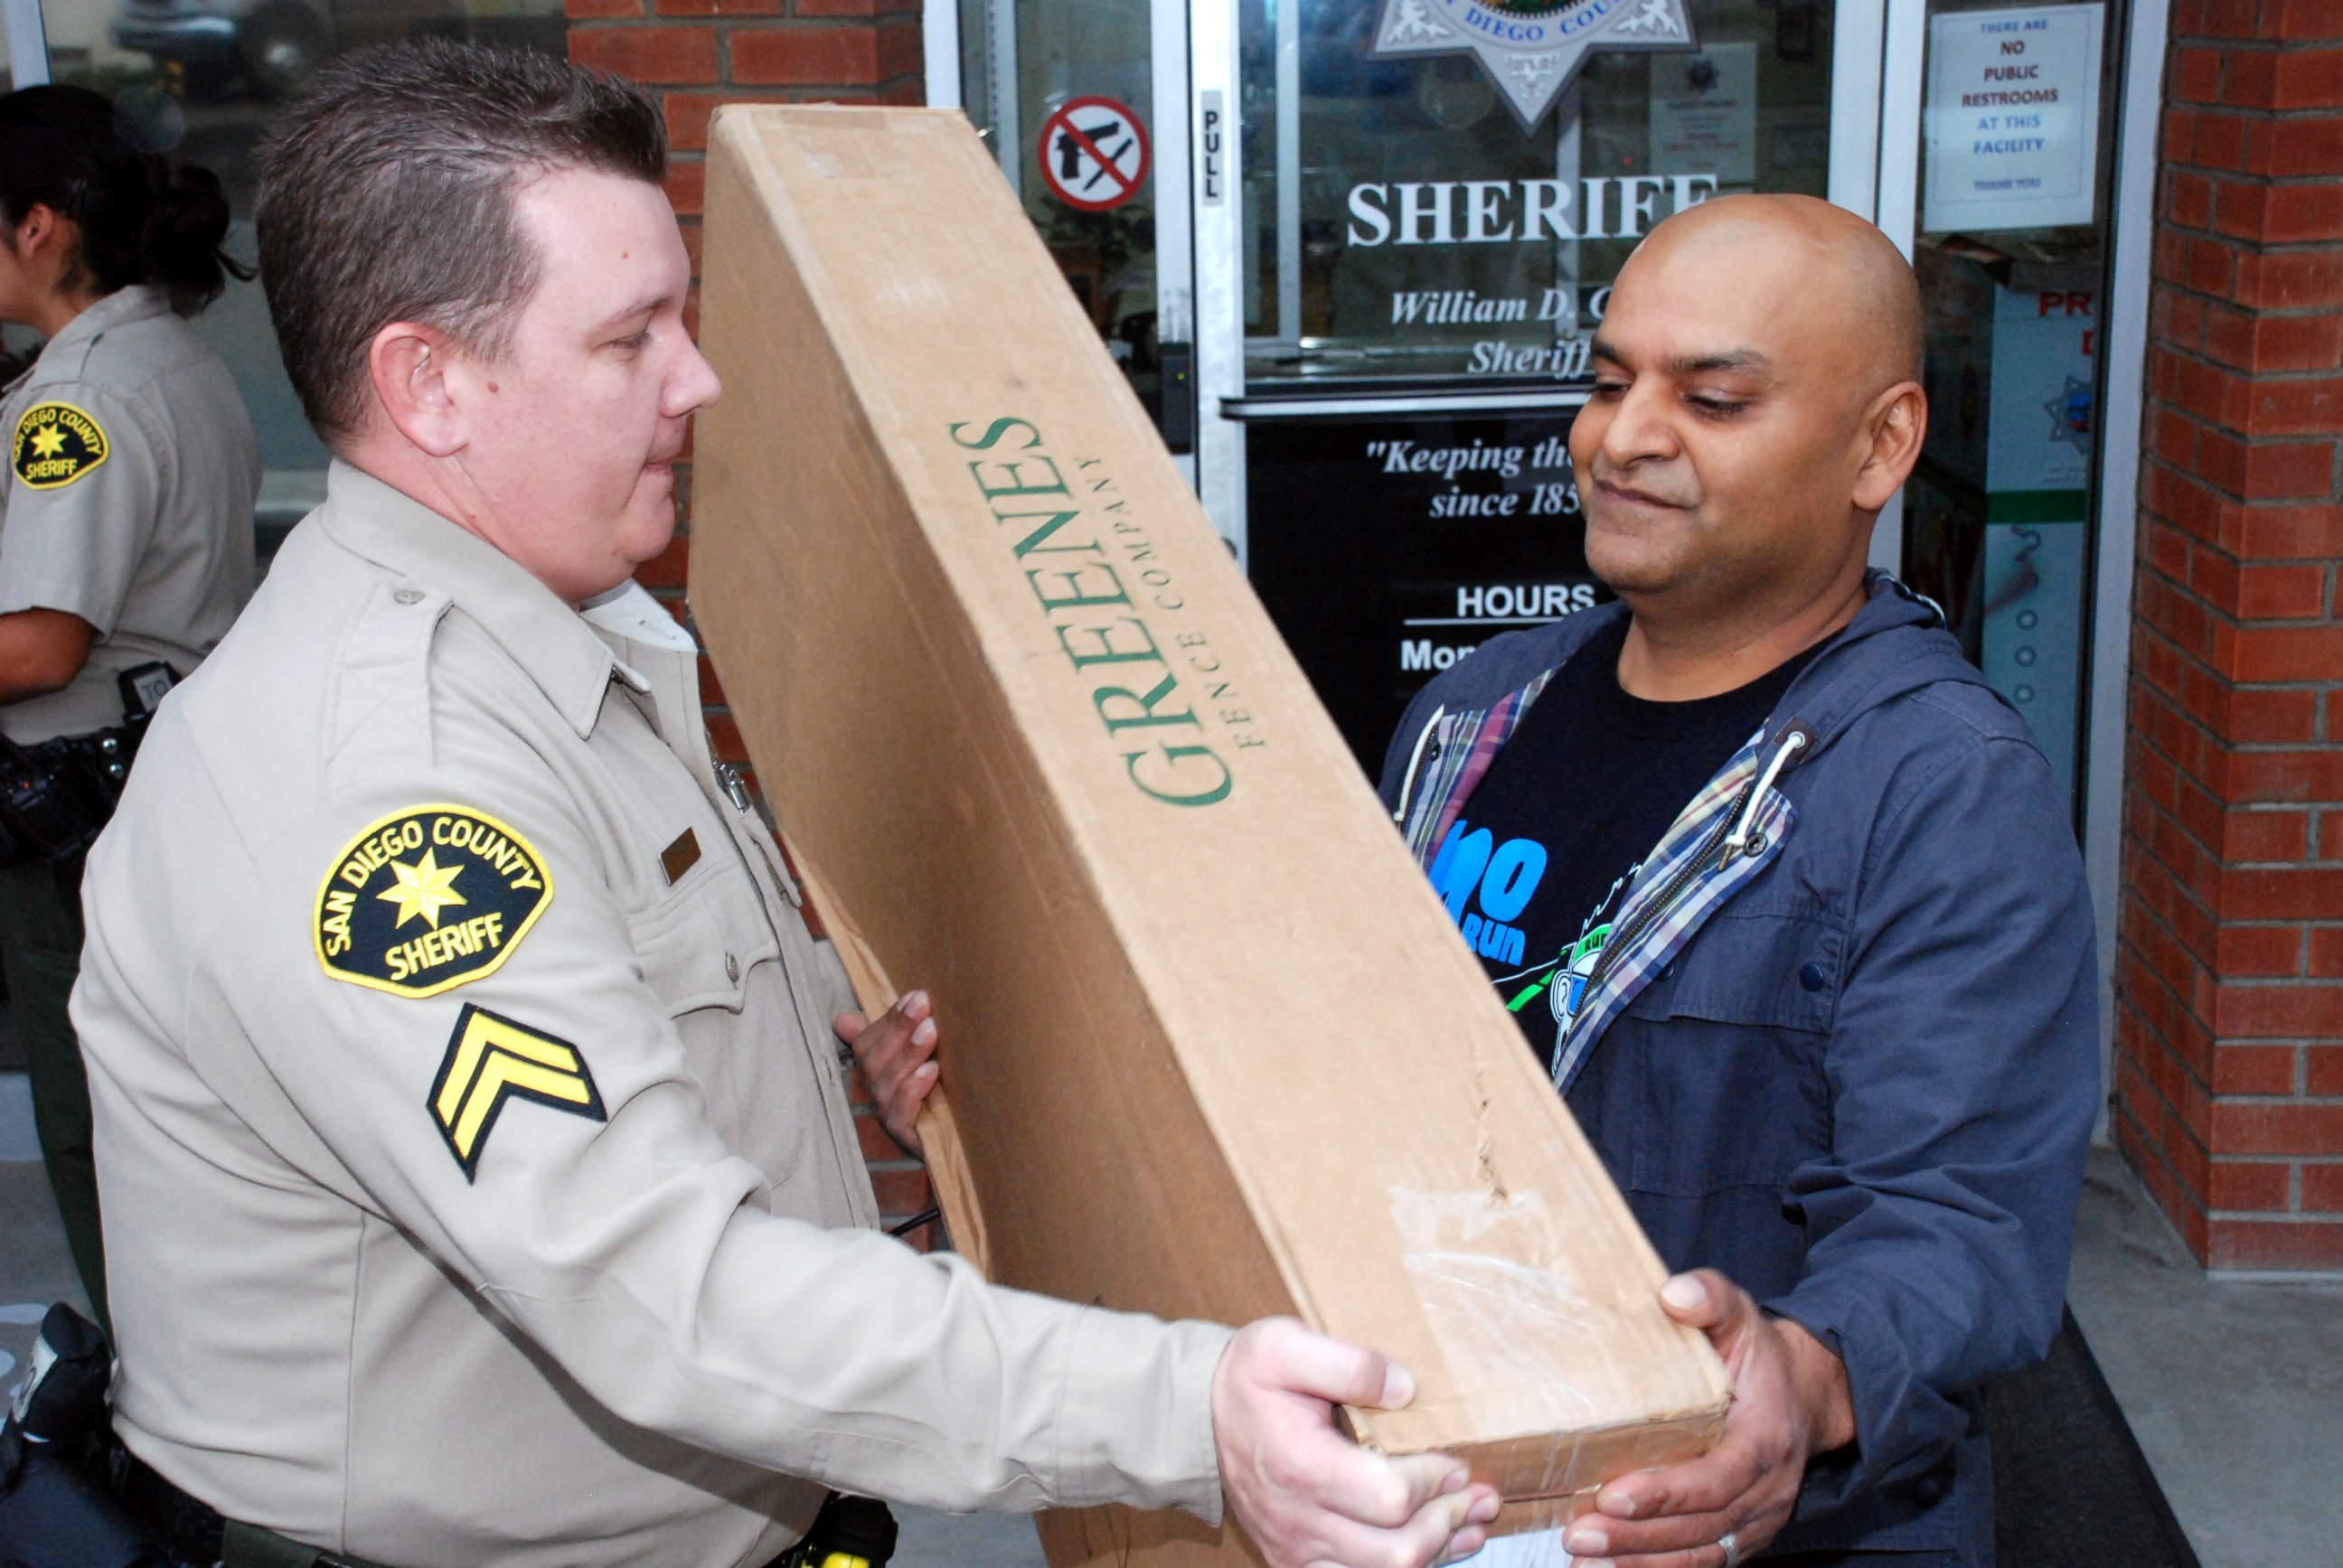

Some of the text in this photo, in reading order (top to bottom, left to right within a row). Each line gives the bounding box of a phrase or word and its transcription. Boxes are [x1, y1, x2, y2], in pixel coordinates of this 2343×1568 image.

[1463, 0, 1620, 41] DIEGO COU
[1981, 19, 2048, 33] THERE ARE
[2000, 41, 2025, 55] NO
[1984, 65, 2038, 81] PUBLIC
[1962, 89, 2058, 108] RESTROOMS
[1977, 115, 2041, 131] AT THIS
[1204, 110, 1219, 198] PULL
[1973, 138, 2045, 155] FACILITY
[1347, 174, 1717, 248] SHERIFF
[1391, 290, 1527, 325] William
[1538, 288, 1575, 321] D.
[1466, 339, 1591, 380] Sheriff
[23, 408, 57, 435] DIEGO
[59, 409, 102, 455] COUNTY
[25, 458, 78, 480] SHERIFF
[1366, 437, 1524, 480] "Keeping
[1429, 485, 1520, 517] since
[946, 416, 1232, 807] GREENES
[1074, 455, 1266, 750] FENCE COMPANY
[1457, 584, 1595, 617] HOURS
[323, 816, 541, 956] SAN DIEGO COUNTY
[384, 912, 503, 981] SHERIFF
